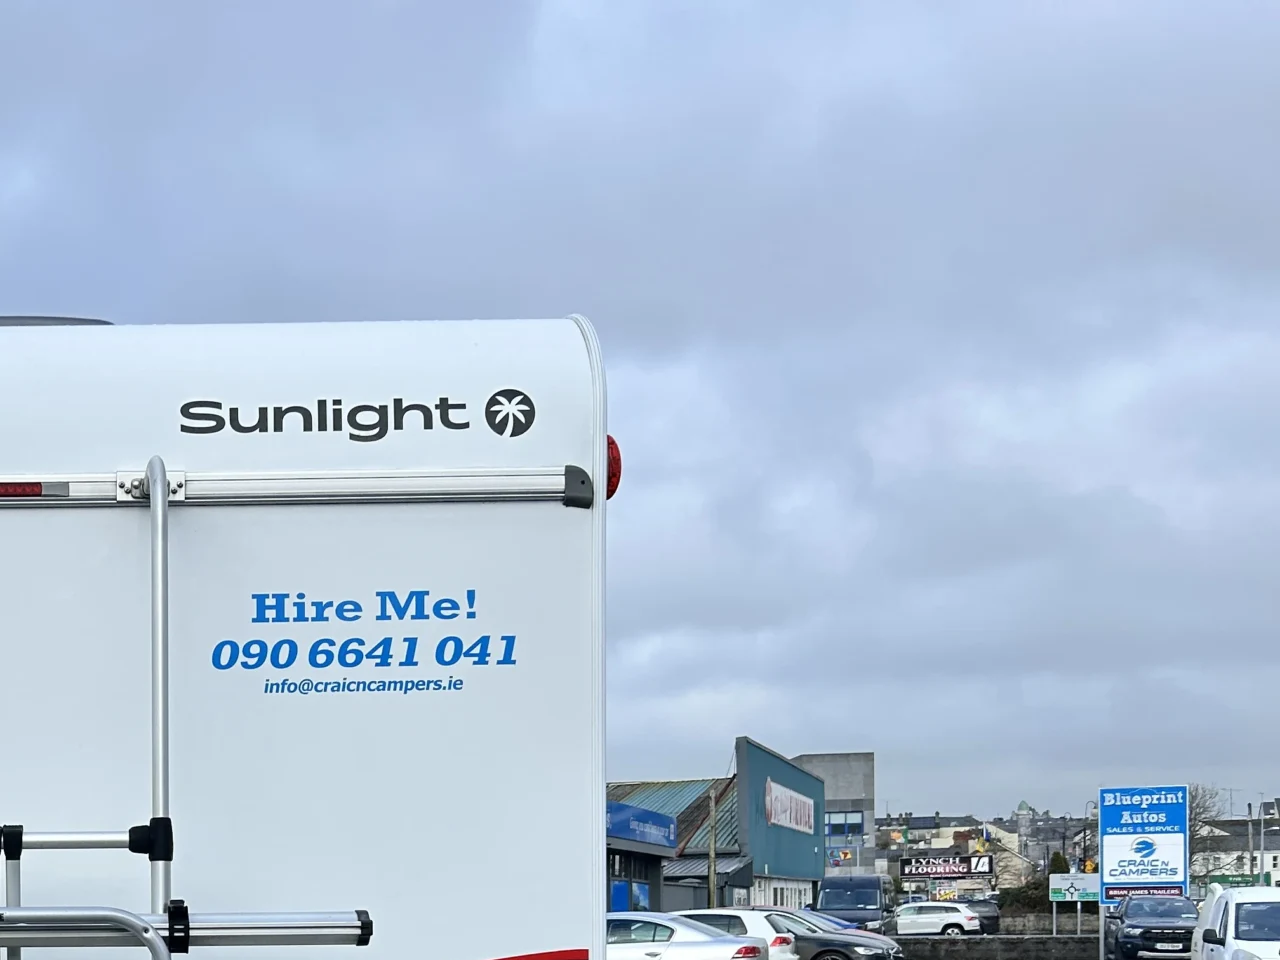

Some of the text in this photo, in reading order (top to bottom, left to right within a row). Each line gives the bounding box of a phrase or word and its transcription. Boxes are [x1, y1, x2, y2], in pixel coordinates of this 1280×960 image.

[180, 397, 470, 443] Sunlight
[251, 589, 477, 624] Hire Me!
[211, 634, 517, 671] 090 6641 041
[263, 676, 464, 694] info@craicncampers.ie
[1103, 791, 1183, 808] Blueprint
[1121, 811, 1166, 823] Autos
[911, 857, 960, 866] LYNCH
[1118, 859, 1160, 868] CRAIC
[904, 865, 968, 874] FLOORING
[1109, 867, 1179, 877] CAMPERS
